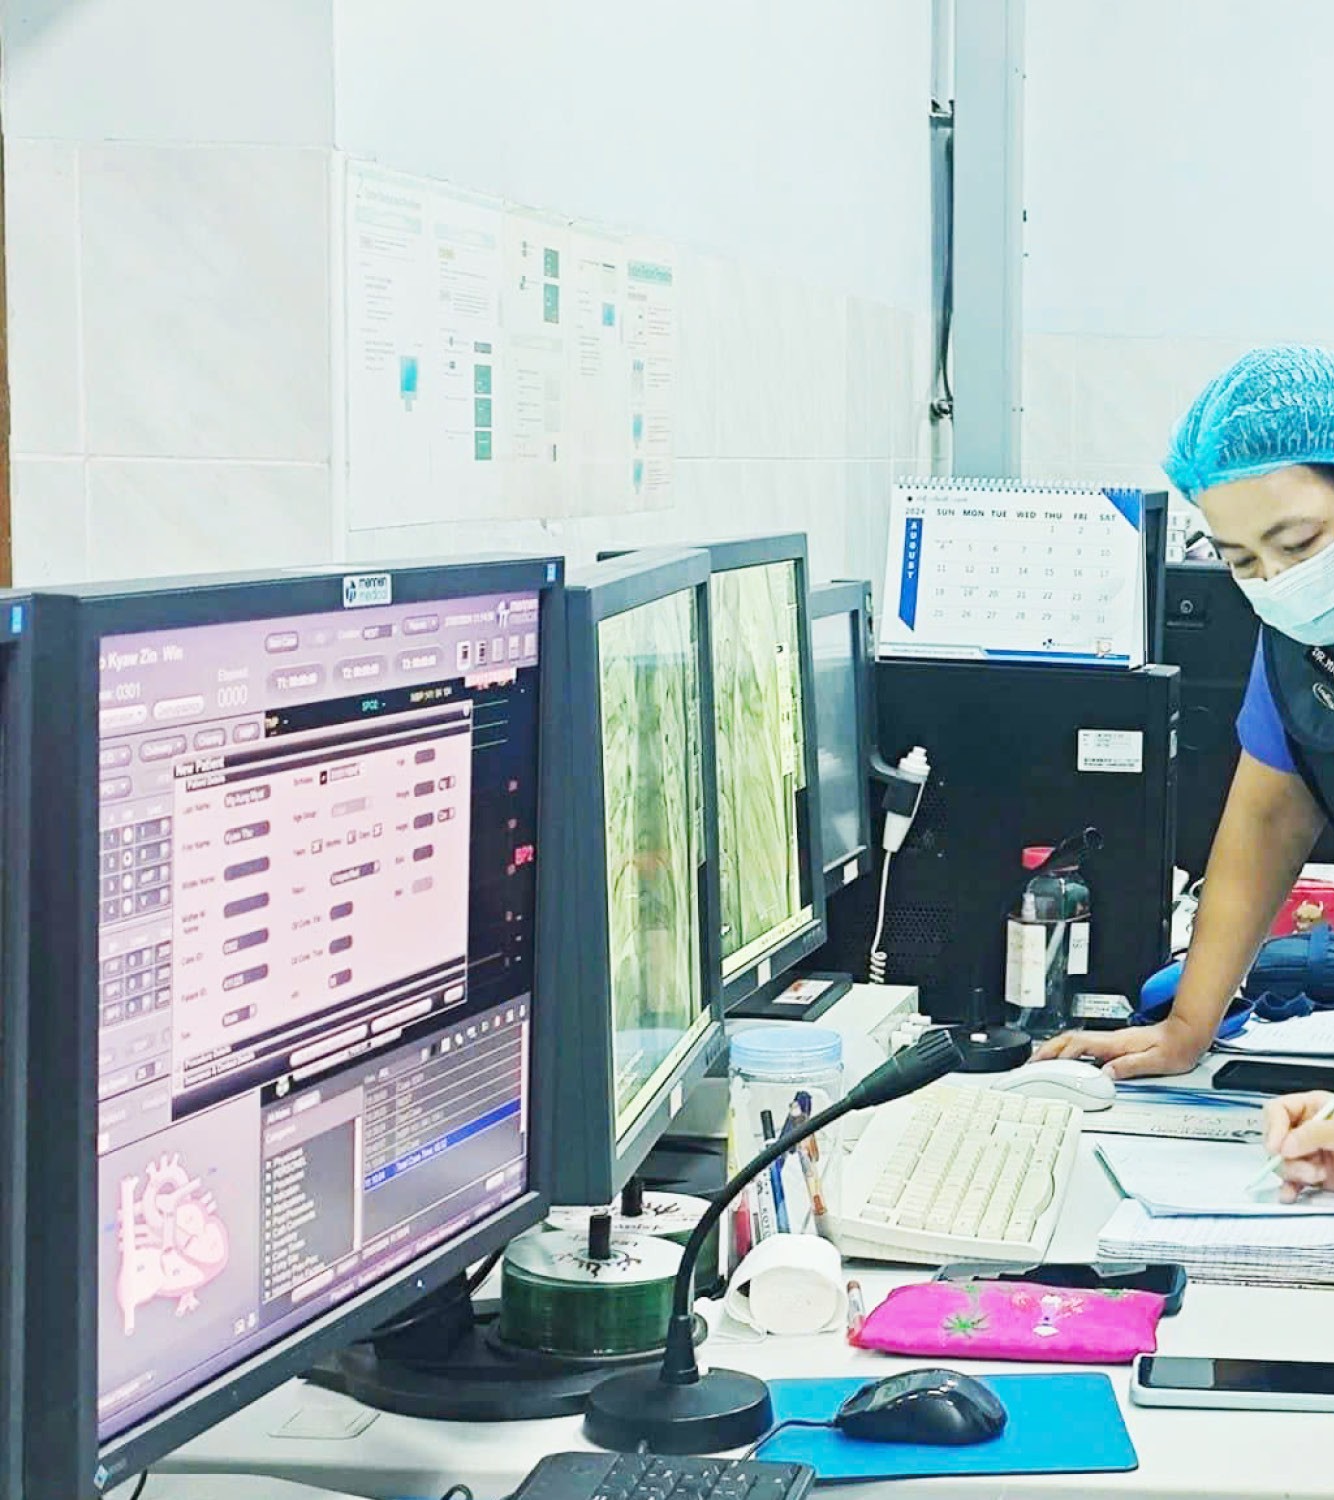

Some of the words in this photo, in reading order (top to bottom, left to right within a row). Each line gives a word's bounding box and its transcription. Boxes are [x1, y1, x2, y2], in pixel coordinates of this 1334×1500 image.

[936, 508, 956, 517] SUN
[963, 509, 985, 517] MON
[991, 509, 1007, 518] TUE
[1016, 511, 1037, 519] WED
[1044, 512, 1063, 520] THU
[1073, 512, 1088, 520] FRI
[1099, 513, 1116, 522] SAT
[906, 521, 919, 579] AUGUST
[140, 647, 157, 665] Zin
[162, 643, 183, 663] Win
